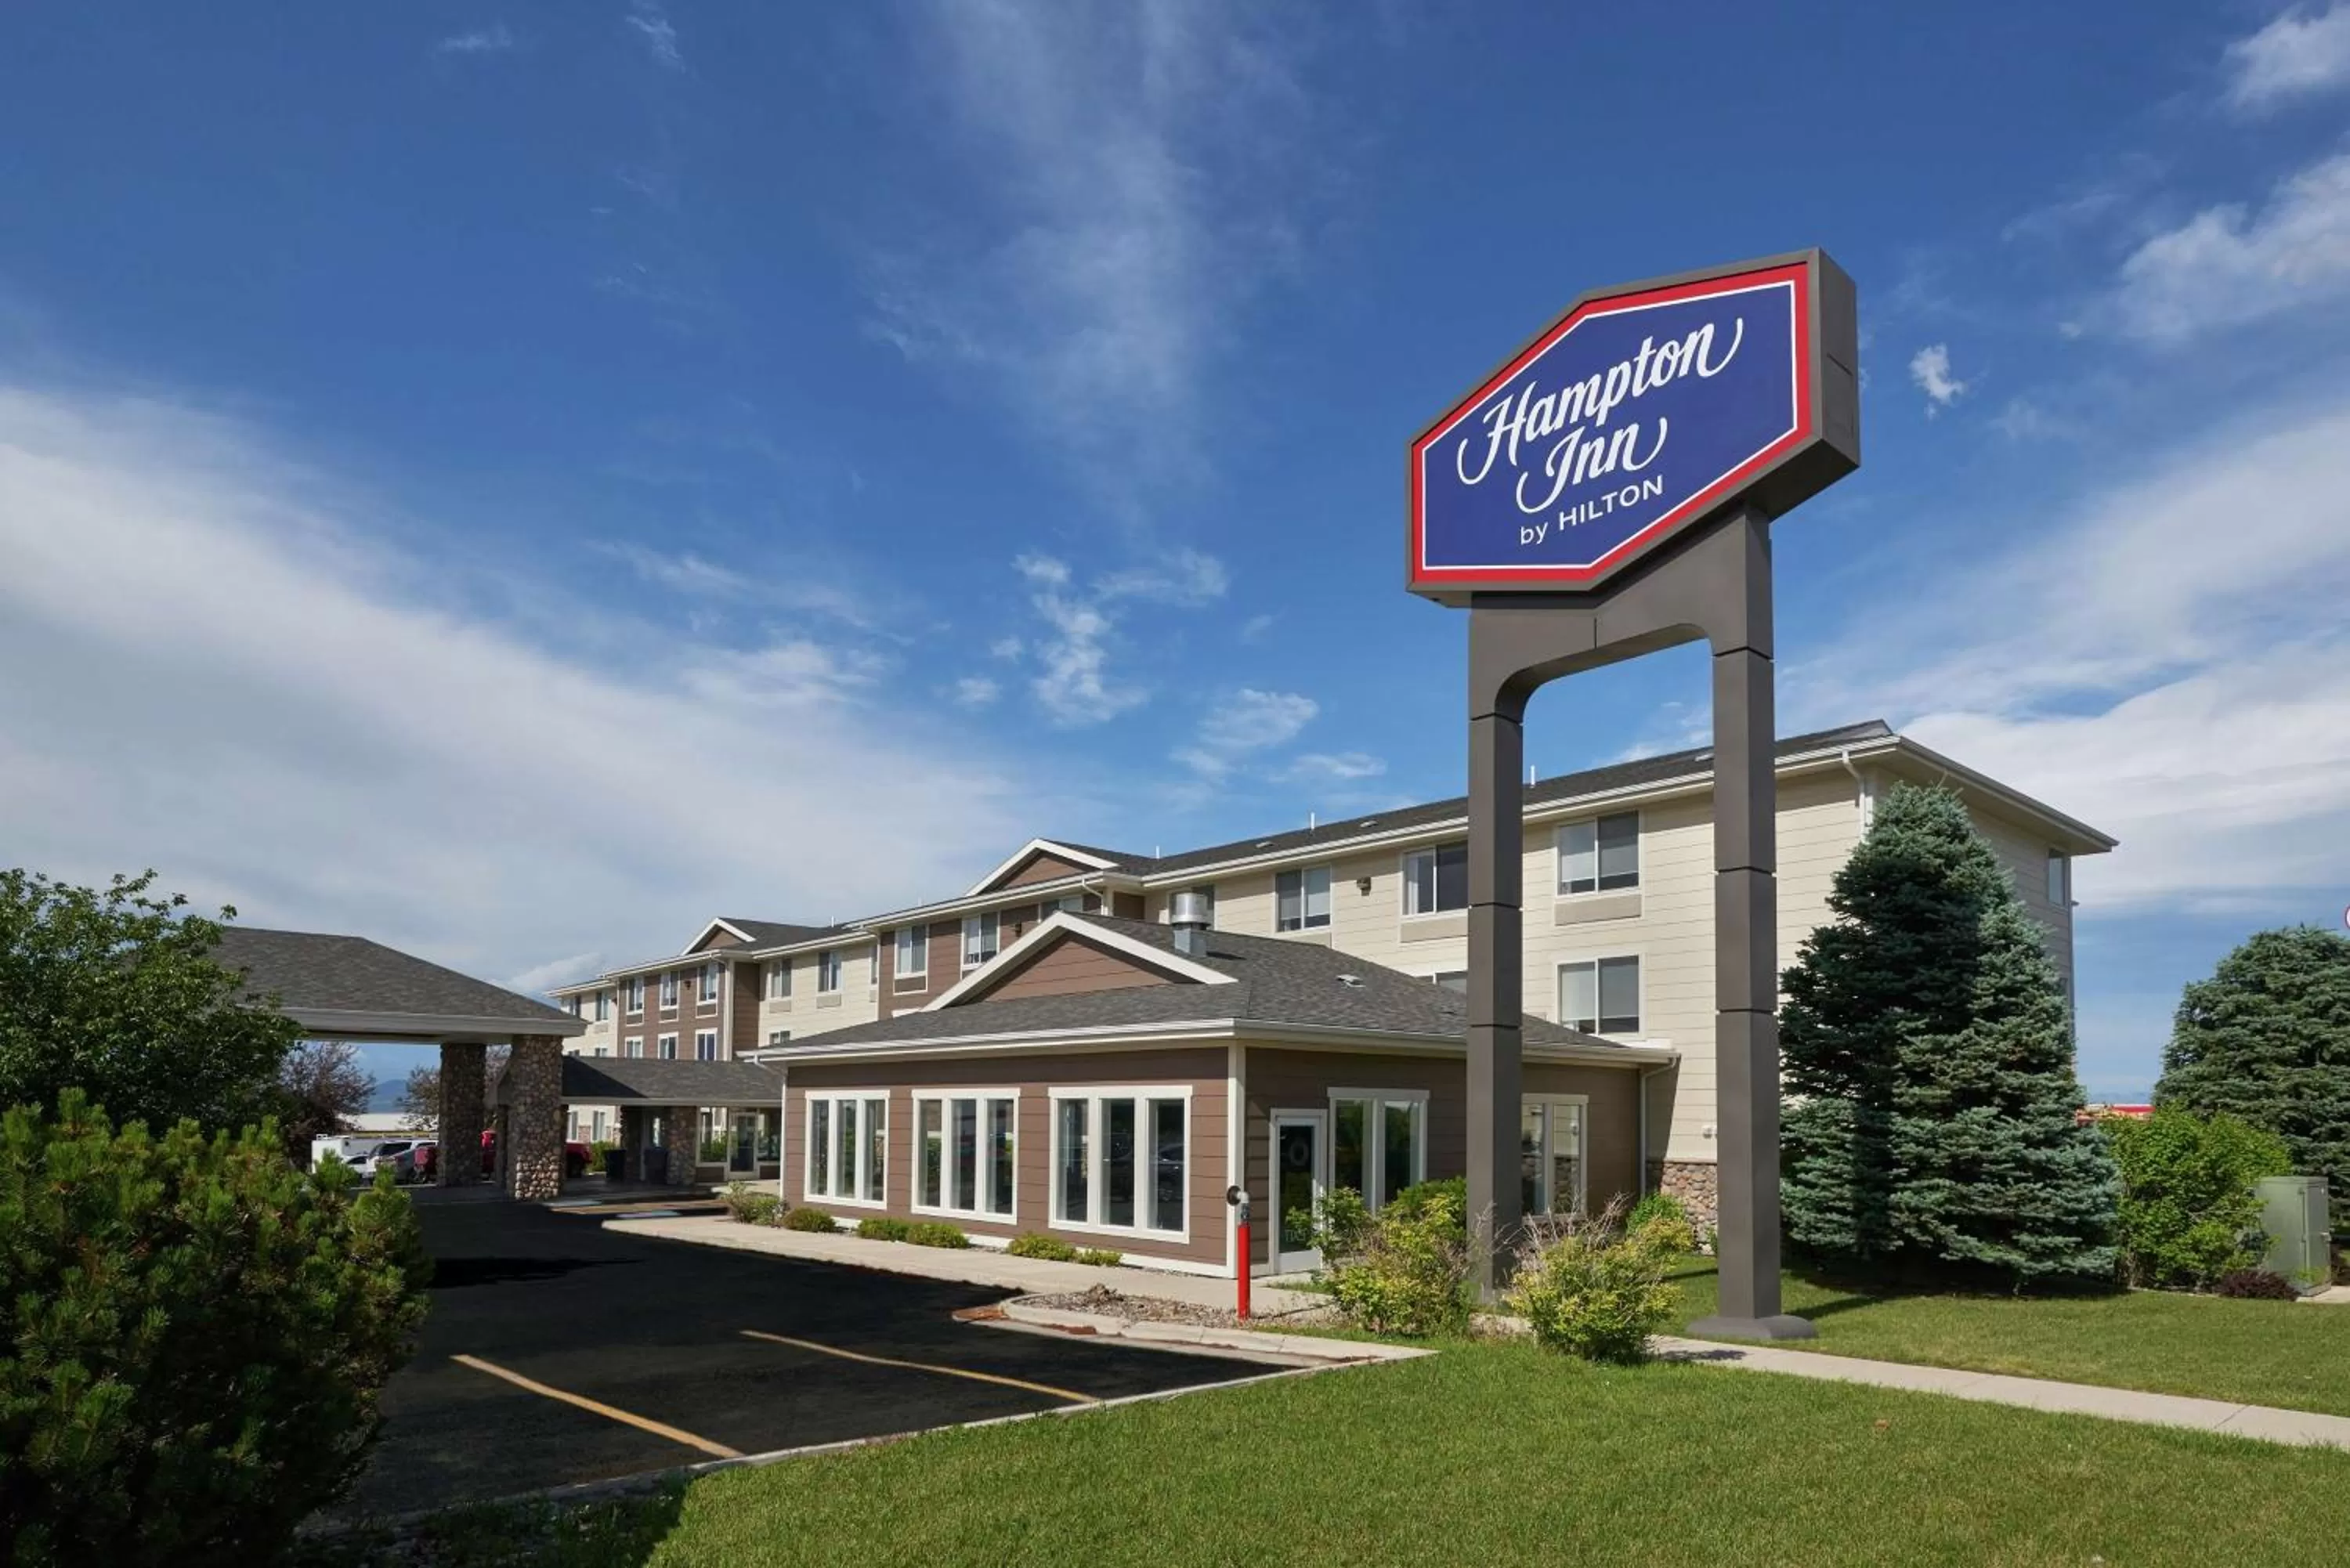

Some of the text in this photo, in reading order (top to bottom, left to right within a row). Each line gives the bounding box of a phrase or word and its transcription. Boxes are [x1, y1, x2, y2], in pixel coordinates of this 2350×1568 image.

[1457, 317, 1743, 485] Hampton
[1516, 417, 1668, 514] Inn
[1520, 475, 1663, 545] by HILTON
